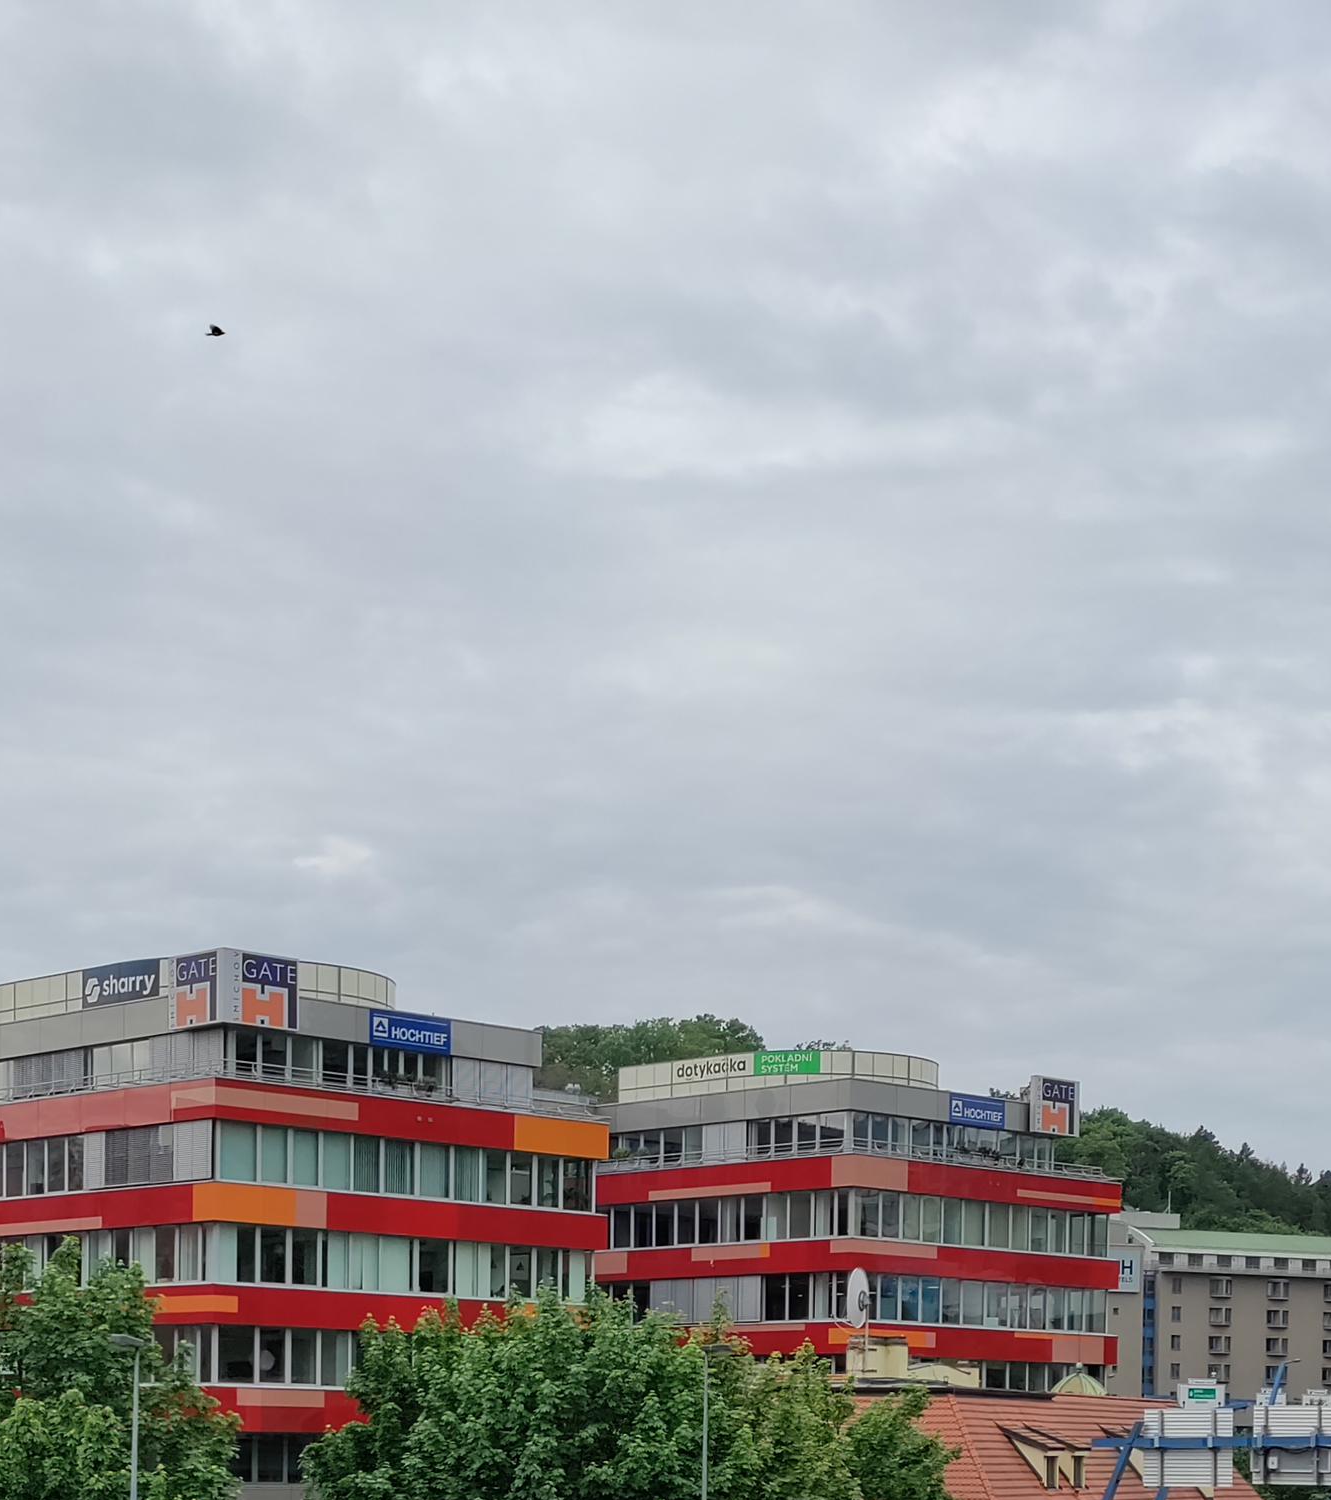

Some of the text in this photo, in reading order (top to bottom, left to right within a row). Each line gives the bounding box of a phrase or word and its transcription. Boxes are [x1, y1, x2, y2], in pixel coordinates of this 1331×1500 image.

[177, 957, 216, 981] GATE
[244, 959, 297, 985] GATE
[102, 973, 156, 996] sharry
[391, 1026, 448, 1046] HOCHTIEF
[761, 1052, 813, 1063] POKLADNÍ
[761, 1063, 799, 1073] SYSTÉM
[1043, 1083, 1075, 1100] GATE
[964, 1108, 1003, 1122] HOCHTIEF
